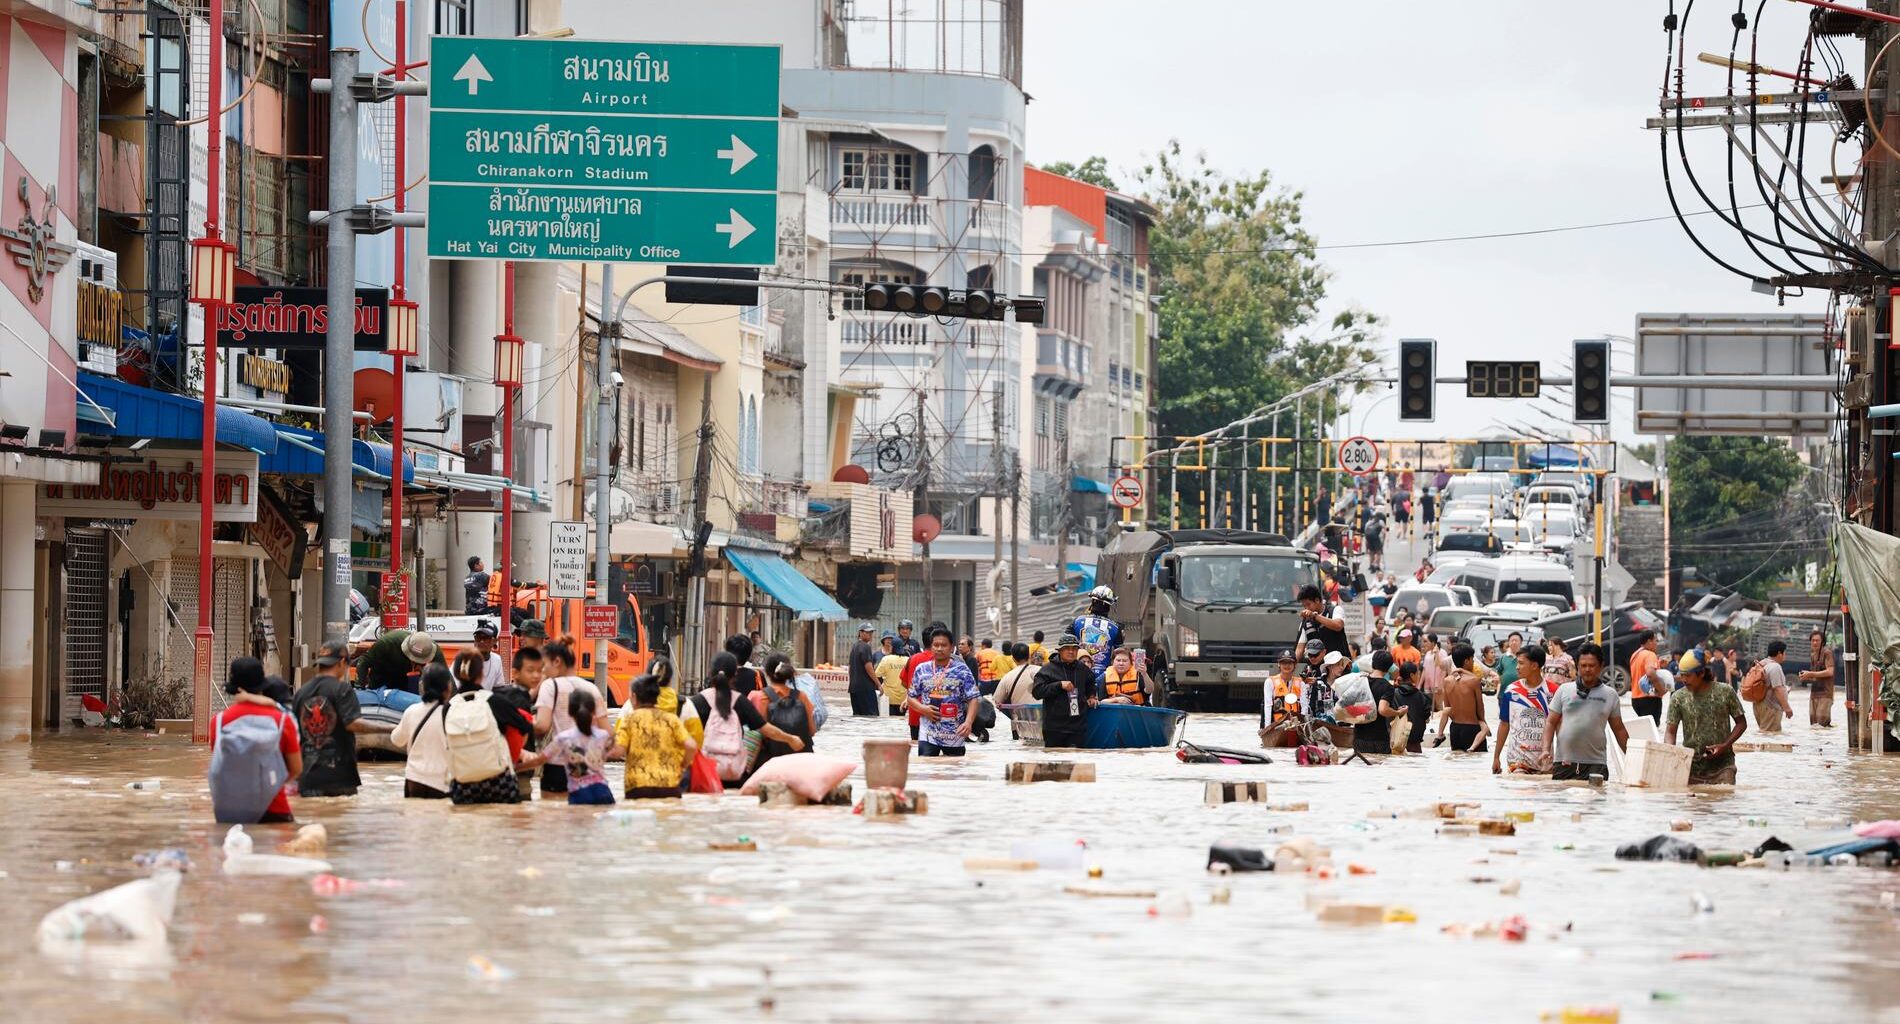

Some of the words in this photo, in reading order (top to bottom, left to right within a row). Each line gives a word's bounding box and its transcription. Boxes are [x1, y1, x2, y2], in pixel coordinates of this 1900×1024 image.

[563, 51, 670, 83] สนามบิน
[582, 91, 648, 107] Airport
[1695, 98, 1702, 107] A
[1763, 96, 1769, 104] B
[1818, 94, 1825, 102] C
[465, 123, 668, 157] สนามกีฬาจิรนคร
[477, 163, 574, 178] Chiranakorn
[585, 166, 648, 180] Stadium
[489, 186, 642, 215] สำนักงานเทศบาล
[487, 213, 601, 243] นครหาดใหญ่
[447, 240, 471, 253] Hat
[477, 241, 499, 254] Yai
[508, 241, 537, 257] City
[548, 243, 633, 259] Municipality
[639, 245, 681, 258] Office
[1344, 448, 1367, 463] 2.80
[567, 547, 585, 555] RED
